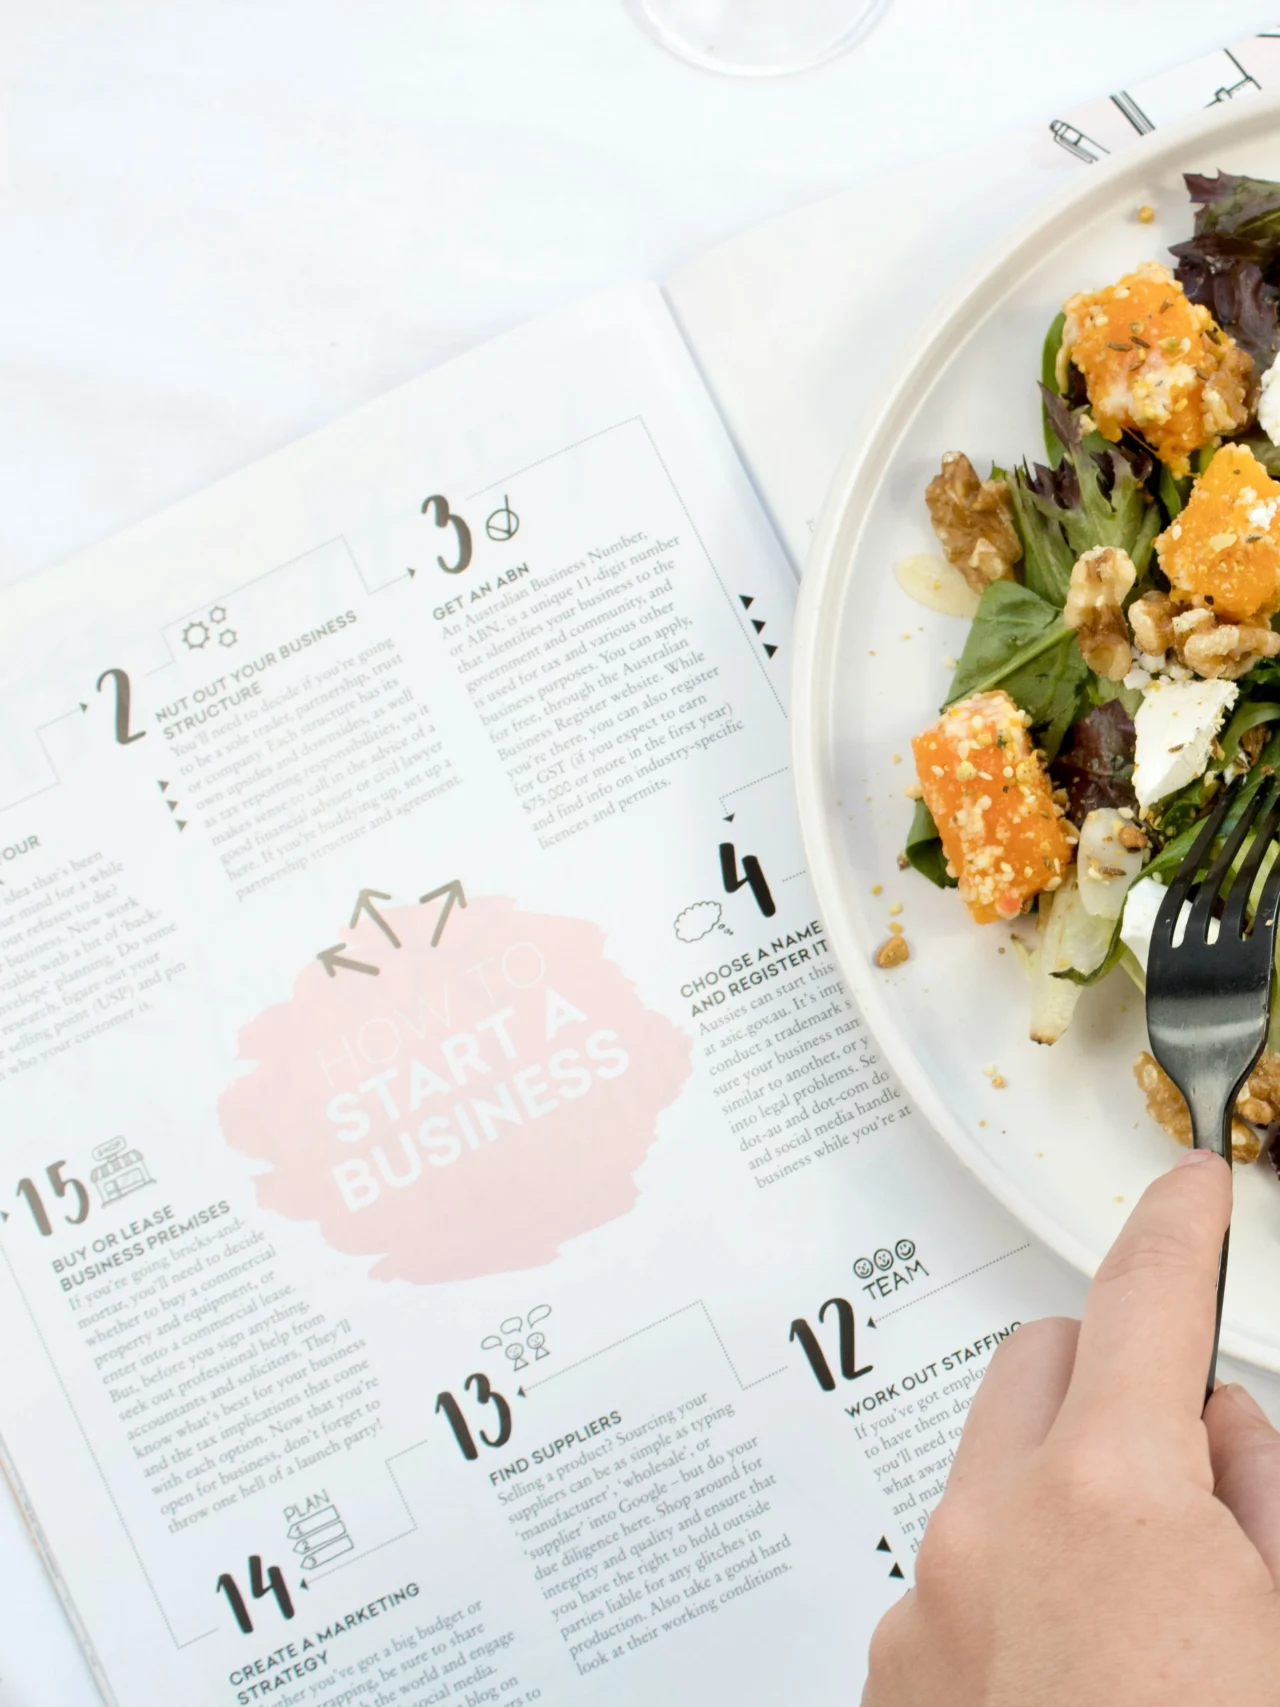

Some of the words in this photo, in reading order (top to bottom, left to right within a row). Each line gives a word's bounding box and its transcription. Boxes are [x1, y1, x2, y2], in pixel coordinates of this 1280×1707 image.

[422, 495, 472, 574] 3
[432, 594, 464, 621] GET
[469, 581, 493, 604] AN
[496, 561, 530, 590] ABN
[153, 695, 189, 724] NUT
[191, 676, 227, 704] OUT
[228, 651, 279, 684] YOUR
[278, 610, 358, 660] BUSINESS
[478, 694, 536, 727] business
[536, 662, 600, 703] purposes.
[597, 646, 628, 665] You
[628, 634, 653, 652] can
[654, 615, 694, 641] apply,
[496, 728, 554, 763] Business
[553, 698, 608, 733] Register
[609, 673, 665, 703] website.
[662, 650, 705, 675] While
[97, 669, 146, 745] 2
[162, 680, 263, 741] STRUCTURE
[520, 779, 573, 815] $75,000
[574, 773, 589, 788] or
[591, 755, 627, 779] more
[626, 747, 643, 761] in
[643, 735, 667, 752] the
[667, 720, 698, 741] first
[698, 701, 734, 730] year)
[532, 809, 556, 833] and
[555, 793, 585, 820] find
[584, 782, 614, 804] info
[614, 773, 635, 789] on
[635, 718, 745, 779] industry-specific
[0, 835, 41, 863] OUR
[537, 818, 590, 851] licences
[591, 799, 617, 823] and
[617, 778, 672, 814] permits.
[719, 843, 776, 917] 4
[679, 952, 755, 999] CHOOSE
[757, 947, 771, 962] A
[769, 919, 824, 954] NAME
[691, 989, 727, 1019] AND
[727, 947, 812, 998] REGISTER
[811, 938, 829, 957] IT
[316, 983, 450, 1087] HOW
[463, 941, 546, 1005] TO
[698, 1004, 749, 1037] Aussies
[749, 992, 775, 1011] can
[775, 975, 807, 998] start
[807, 961, 835, 982] this
[704, 1043, 717, 1058] at
[719, 1007, 792, 1049] asic.gov.au.
[708, 1042, 764, 1077] conduct
[764, 1037, 774, 1049] a
[773, 1000, 844, 1043] trademark
[326, 1006, 518, 1142] START
[545, 986, 589, 1042] A
[331, 1028, 629, 1213] BUSINESS
[748, 1147, 773, 1171] and
[774, 1126, 813, 1158] social
[813, 1109, 856, 1138] media
[753, 1154, 813, 1190] business
[812, 1133, 851, 1159] while
[851, 1112, 896, 1145] you're
[17, 1161, 89, 1236] 15
[51, 1245, 87, 1275] BUY
[91, 1232, 120, 1254] OR
[119, 1204, 176, 1241] LEASE
[59, 1242, 146, 1293] BUSINESS
[145, 1199, 231, 1251] PREMISES
[862, 1260, 929, 1300] TEAM
[93, 1331, 152, 1372] property
[156, 1312, 182, 1337] and
[182, 1280, 260, 1324] equipment,
[259, 1269, 275, 1285] or
[790, 1298, 873, 1391] 12
[118, 1397, 151, 1423] seek
[150, 1387, 176, 1407] out
[176, 1341, 260, 1398] professional
[257, 1329, 291, 1353] help
[290, 1313, 326, 1337] from
[843, 1383, 901, 1419] WORK
[901, 1361, 938, 1392] OUT
[143, 1454, 170, 1479] and
[170, 1446, 194, 1464] the
[195, 1435, 219, 1452] tax
[217, 1393, 303, 1441] implications
[302, 1377, 331, 1399] that
[332, 1359, 370, 1385] come
[436, 1373, 511, 1460] 13
[488, 1457, 530, 1487] FIND
[531, 1410, 623, 1465] SUPPLIERS
[496, 1476, 547, 1507] Selling
[546, 1472, 555, 1483] a
[555, 1437, 614, 1482] product?
[614, 1409, 678, 1447] Sourcing
[675, 1392, 708, 1421] your
[863, 1445, 881, 1460] to
[878, 1428, 913, 1451] have
[913, 1409, 951, 1434] them
[507, 1488, 568, 1525] suppliers
[568, 1475, 593, 1494] can
[591, 1465, 612, 1481] be
[613, 1457, 628, 1472] as
[629, 1432, 673, 1462] simple
[675, 1426, 690, 1441] as
[689, 1403, 736, 1433] typing
[283, 1488, 330, 1523] PLAN
[533, 1561, 560, 1581] due
[561, 1531, 620, 1568] diligence
[618, 1515, 657, 1538] here.
[655, 1494, 692, 1519] Shop
[692, 1464, 741, 1501] around
[740, 1457, 763, 1476] for
[539, 1564, 599, 1601] integrity
[602, 1545, 628, 1571] and
[628, 1525, 674, 1559] quality
[677, 1507, 703, 1532] and
[703, 1489, 748, 1519] ensure
[748, 1474, 777, 1495] that
[217, 1555, 294, 1634] 14
[228, 1642, 299, 1687] CREATE
[301, 1637, 316, 1653] A
[315, 1581, 420, 1644] MARKETING
[574, 1650, 610, 1676] look
[611, 1644, 627, 1660] at
[625, 1625, 659, 1652] their
[660, 1598, 720, 1633] working
[718, 1562, 793, 1605] conditions.
[236, 1649, 328, 1706] STRATEGY
[373, 1690, 398, 1707] the
[398, 1664, 440, 1695] world
[441, 1649, 468, 1676] and
[468, 1631, 515, 1661] engage
